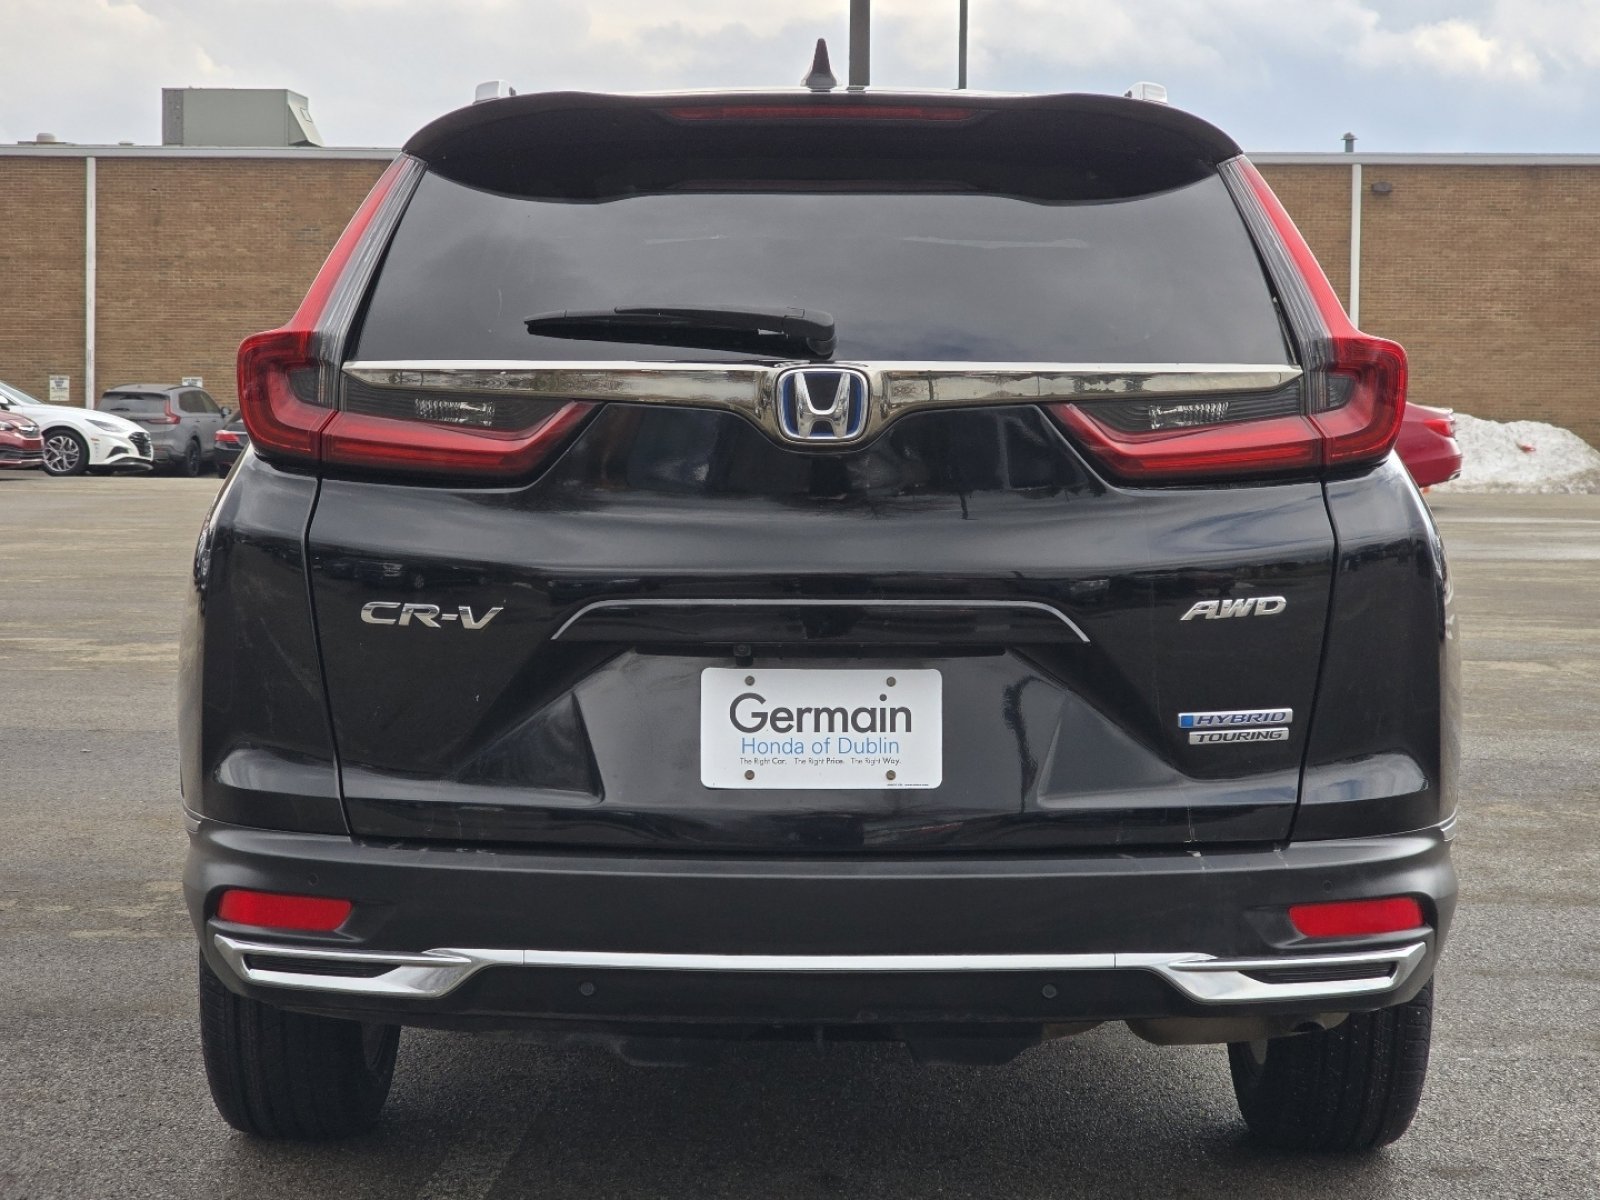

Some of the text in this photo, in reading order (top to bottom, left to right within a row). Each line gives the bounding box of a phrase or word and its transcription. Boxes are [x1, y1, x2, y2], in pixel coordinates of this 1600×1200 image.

[360, 601, 504, 630] CR-V
[1180, 596, 1287, 621] AWD
[729, 692, 912, 733] Germain
[1197, 712, 1286, 725] HYBRID
[741, 737, 900, 755] Honda of Dublin
[1197, 731, 1282, 743] TOURING
[740, 757, 752, 765] The
[754, 757, 770, 766] Right
[794, 757, 806, 765] The
[809, 757, 825, 766] Right
[851, 757, 863, 765] The
[865, 757, 881, 766] Right
